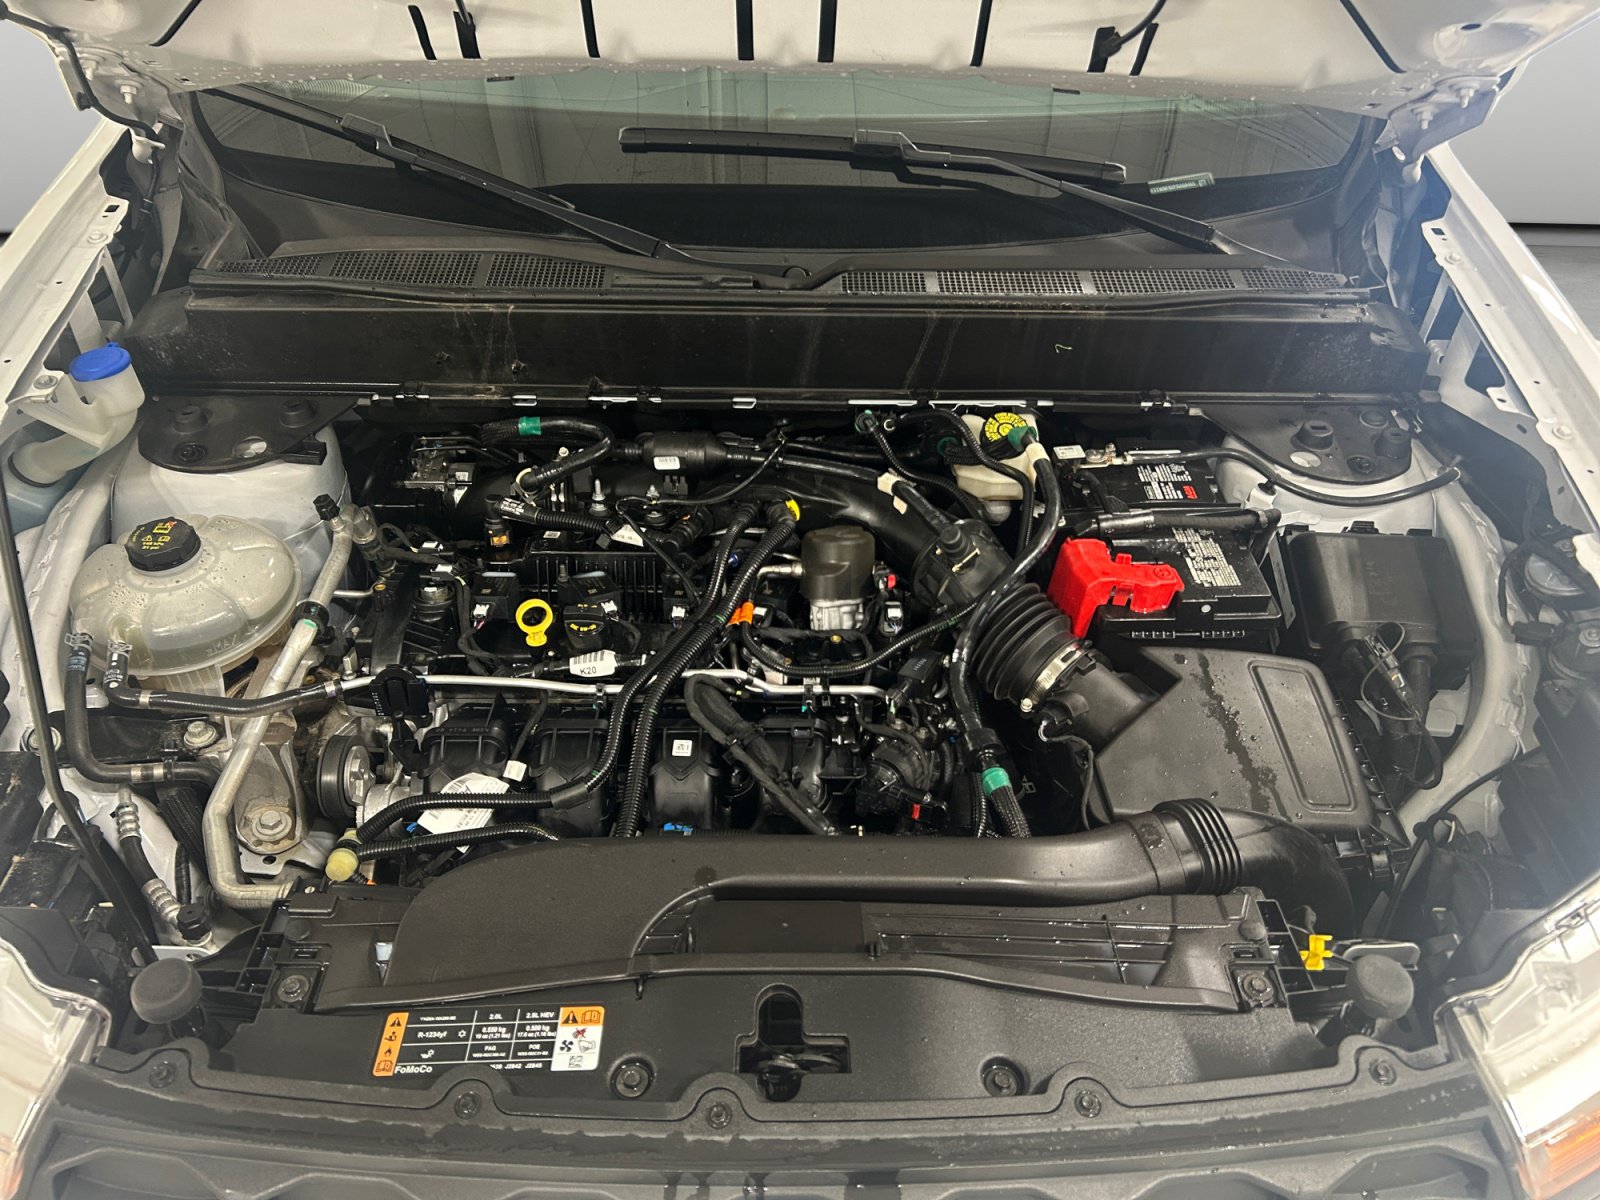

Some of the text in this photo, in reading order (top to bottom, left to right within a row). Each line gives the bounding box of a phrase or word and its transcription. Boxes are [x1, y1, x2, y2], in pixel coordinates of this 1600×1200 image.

[580, 666, 597, 675] K20
[498, 1026, 507, 1034] kg
[417, 1031, 447, 1039] R-1234yf
[394, 1065, 433, 1074] FoMoCo
